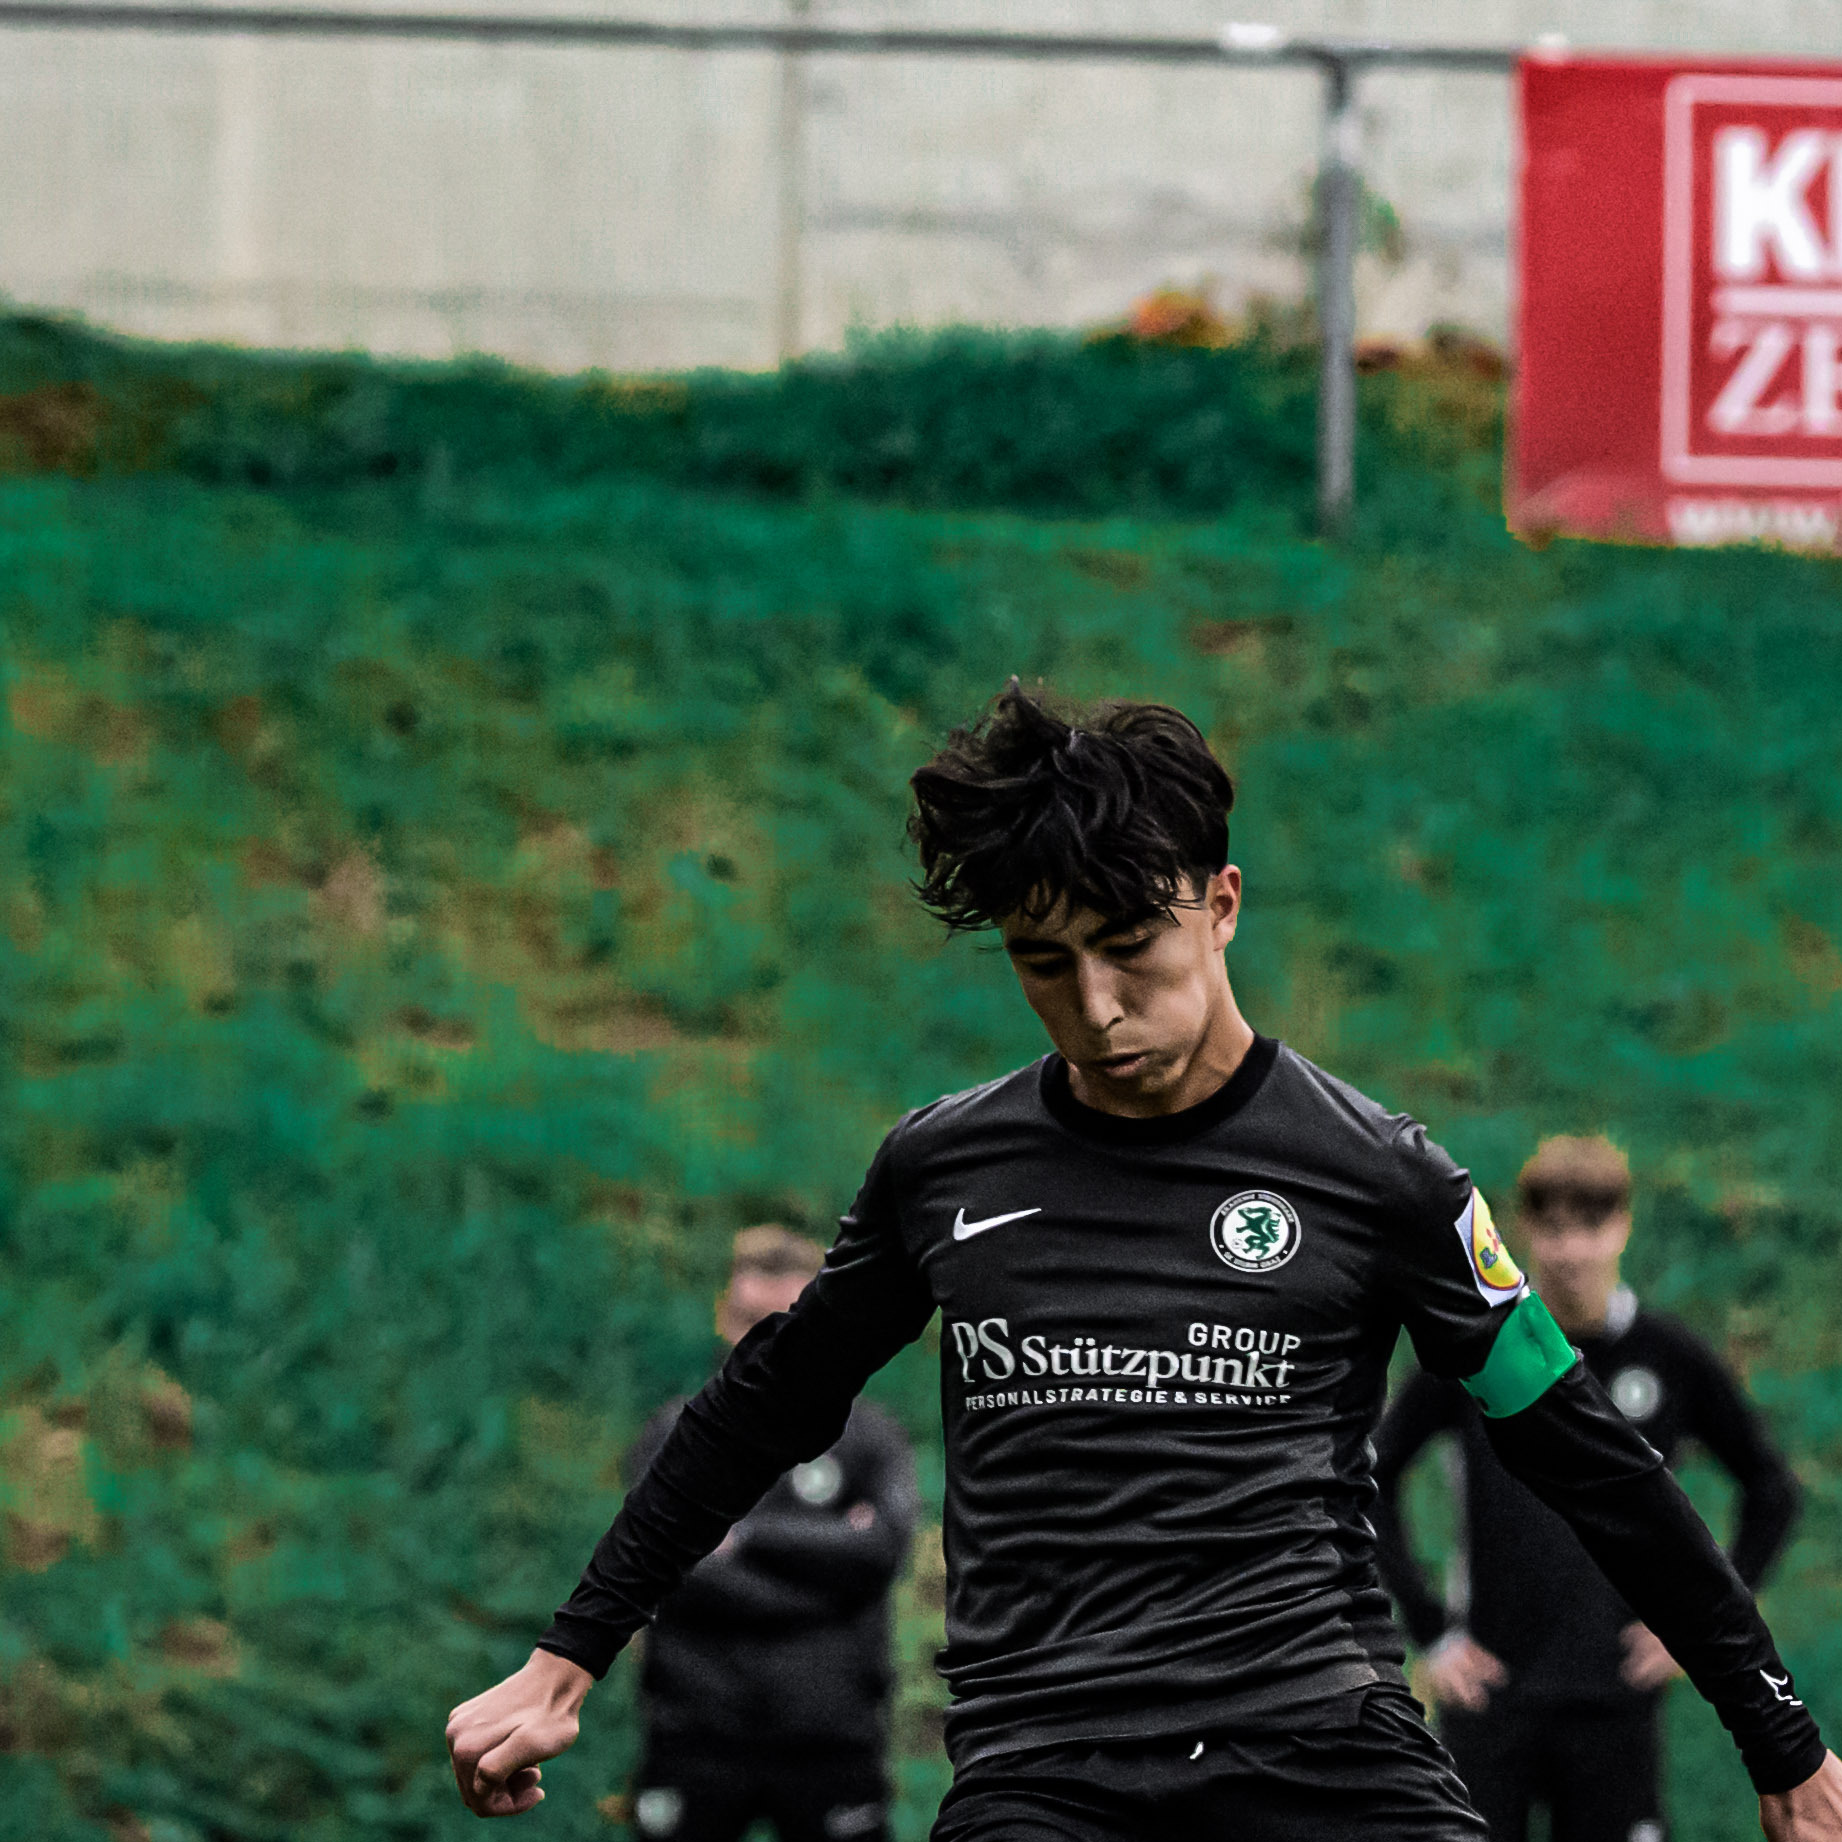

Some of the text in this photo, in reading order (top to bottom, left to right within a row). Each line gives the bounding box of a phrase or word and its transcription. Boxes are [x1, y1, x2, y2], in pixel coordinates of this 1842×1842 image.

[951, 1317, 1297, 1390] PS Stützpunkt
[1187, 1321, 1302, 1357] GROUP
[965, 1387, 1169, 1411] PERSONALSTRATEGIE
[1174, 1391, 1188, 1405] &
